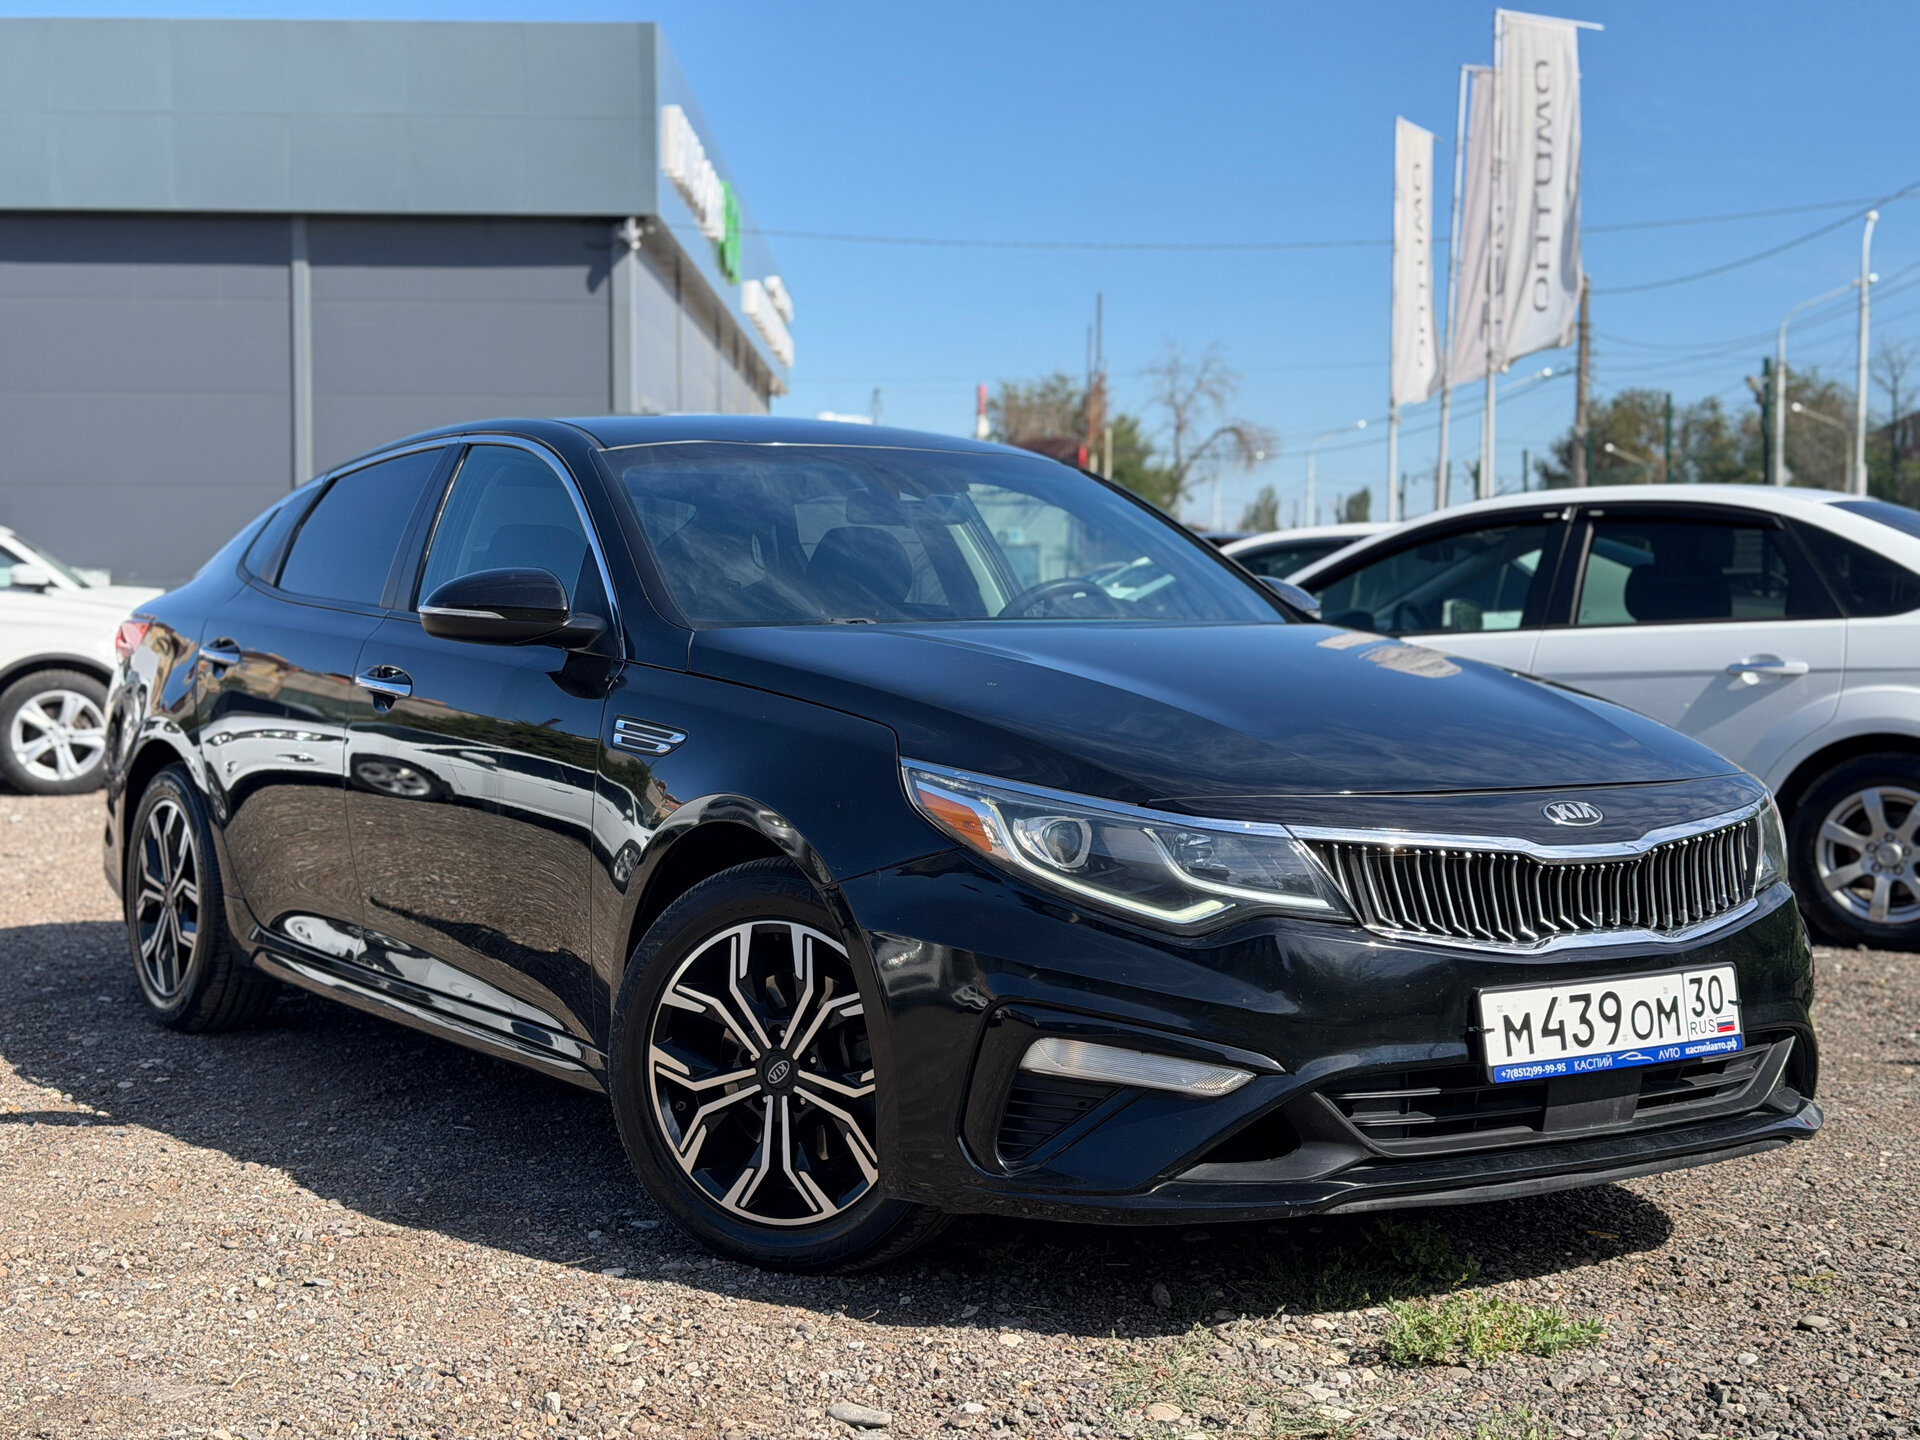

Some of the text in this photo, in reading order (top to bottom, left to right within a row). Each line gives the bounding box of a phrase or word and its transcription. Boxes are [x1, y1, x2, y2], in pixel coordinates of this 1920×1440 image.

[1550, 803, 1599, 820] KIA
[1689, 975, 1724, 1018] 30
[1690, 1019, 1715, 1035] RUS
[1501, 1063, 1567, 1080] +7(8512)99-99-95
[1574, 1055, 1613, 1071] КАСПИЙ
[1685, 1038, 1738, 1055] каспийавто.рф
